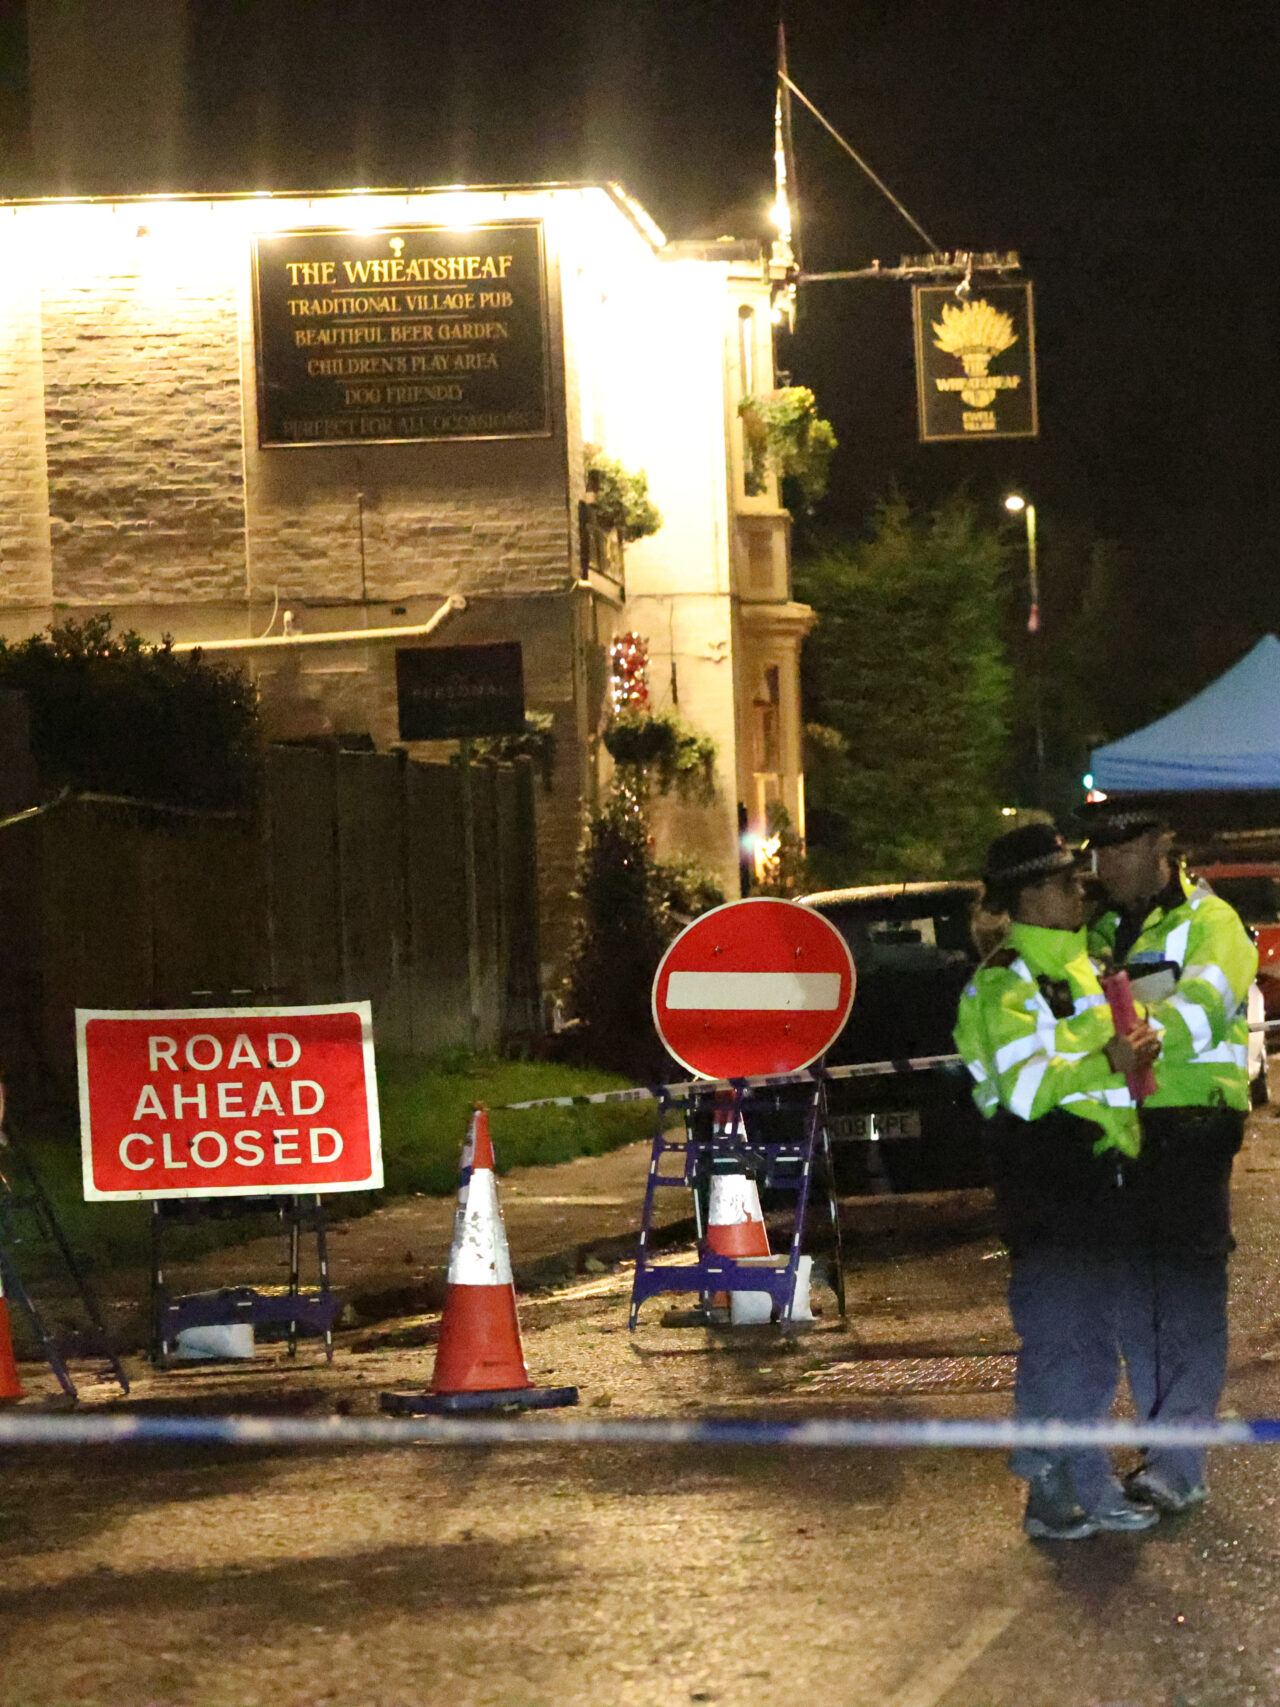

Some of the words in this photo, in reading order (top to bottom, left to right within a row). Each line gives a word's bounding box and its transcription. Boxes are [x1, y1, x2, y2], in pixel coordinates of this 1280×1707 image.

[286, 261, 336, 286] THE
[343, 255, 513, 283] WHEATSHEAF
[288, 296, 401, 316] TRADITIONAL
[405, 293, 475, 311] VILLAGE
[479, 291, 513, 309] PUB
[295, 327, 385, 346] BEAUTIFUL
[391, 325, 433, 342] BEER
[438, 322, 508, 340] GARDEN
[412, 354, 449, 372] PLAY
[453, 352, 498, 370] AREA
[345, 388, 380, 405] DOG
[148, 1032, 302, 1072] ROAD
[132, 1080, 325, 1121] AHEAD
[118, 1127, 344, 1171] CLOSED
